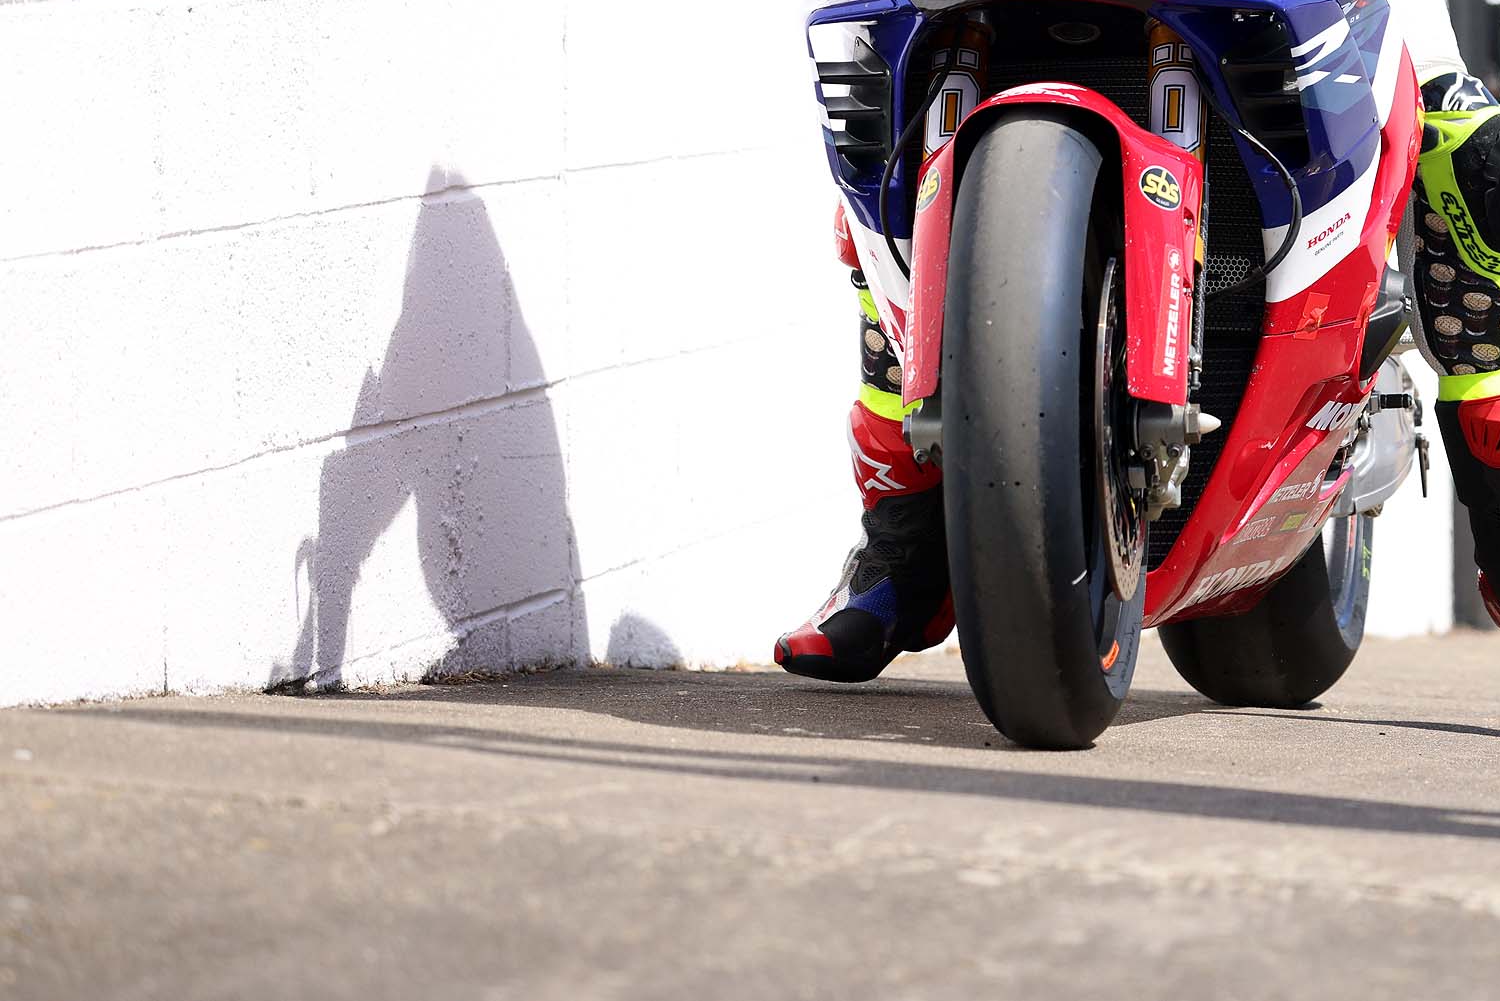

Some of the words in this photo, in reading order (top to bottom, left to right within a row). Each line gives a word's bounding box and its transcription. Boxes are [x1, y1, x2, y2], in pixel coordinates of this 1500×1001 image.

[1142, 169, 1180, 204] sbs
[1306, 211, 1352, 250] HONDA
[1162, 275, 1182, 377] METZELER
